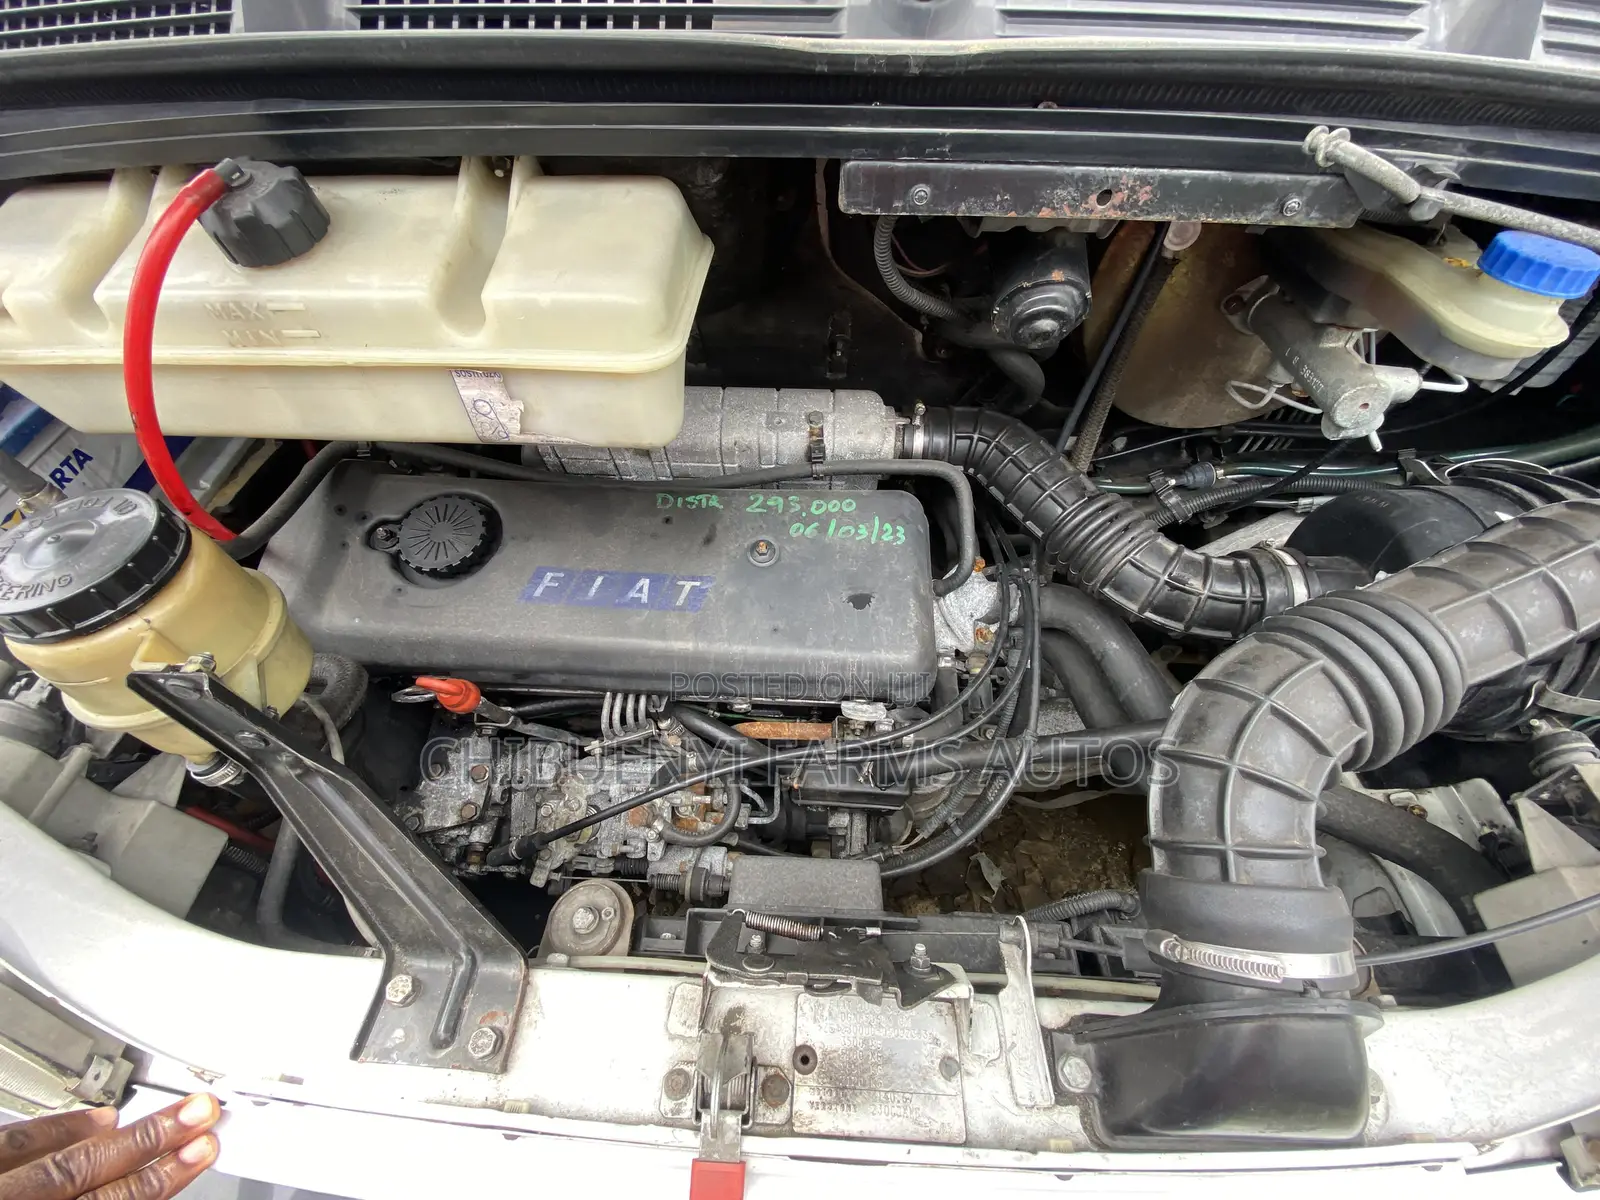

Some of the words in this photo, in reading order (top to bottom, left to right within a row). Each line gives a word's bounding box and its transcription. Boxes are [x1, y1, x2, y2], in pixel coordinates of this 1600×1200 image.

[203, 301, 265, 320] MAX
[221, 328, 285, 347] MIN
[49, 448, 93, 490] RTA
[746, 493, 857, 517] 293.000
[789, 516, 906, 545] 06/03/23
[532, 571, 701, 606] FIAT
